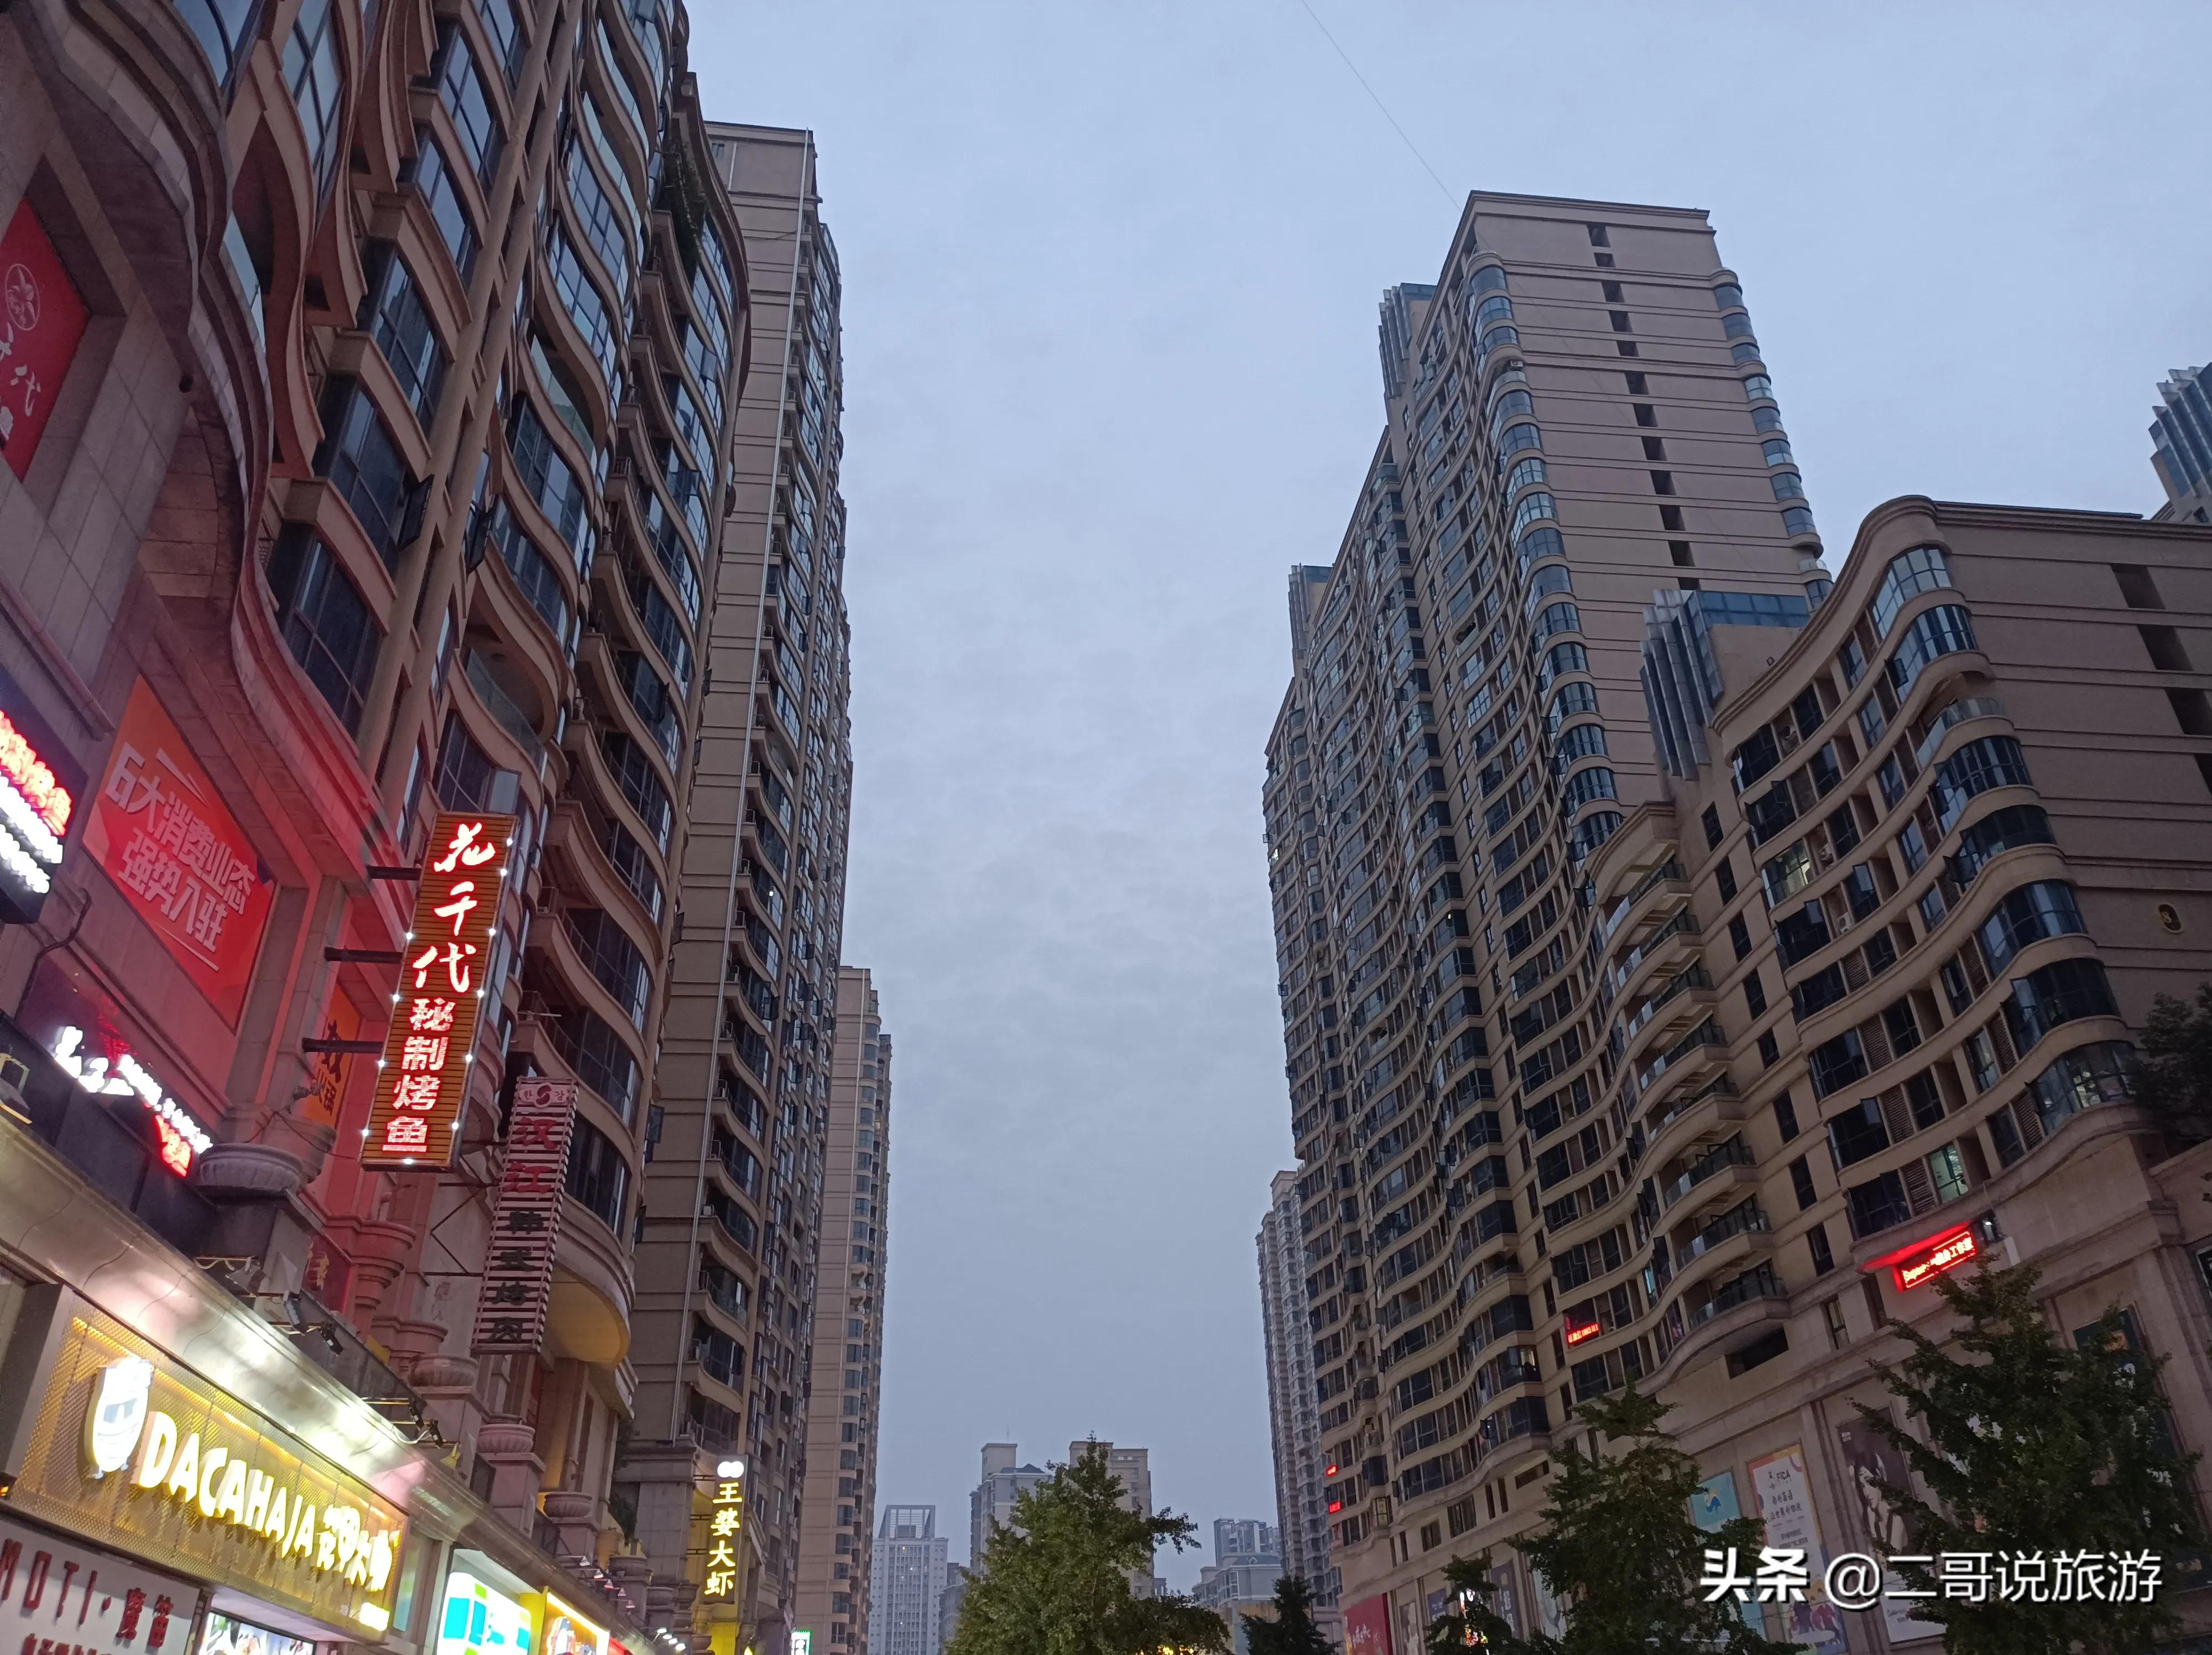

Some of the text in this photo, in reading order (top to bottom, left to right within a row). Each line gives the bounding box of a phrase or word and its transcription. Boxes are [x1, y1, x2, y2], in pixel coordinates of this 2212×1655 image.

[105, 742, 258, 915] 6大消费业态
[118, 828, 227, 953] 强势入驻
[136, 1411, 315, 1559] DACAHAJA
[705, 1481, 743, 1597] 王婆大虾
